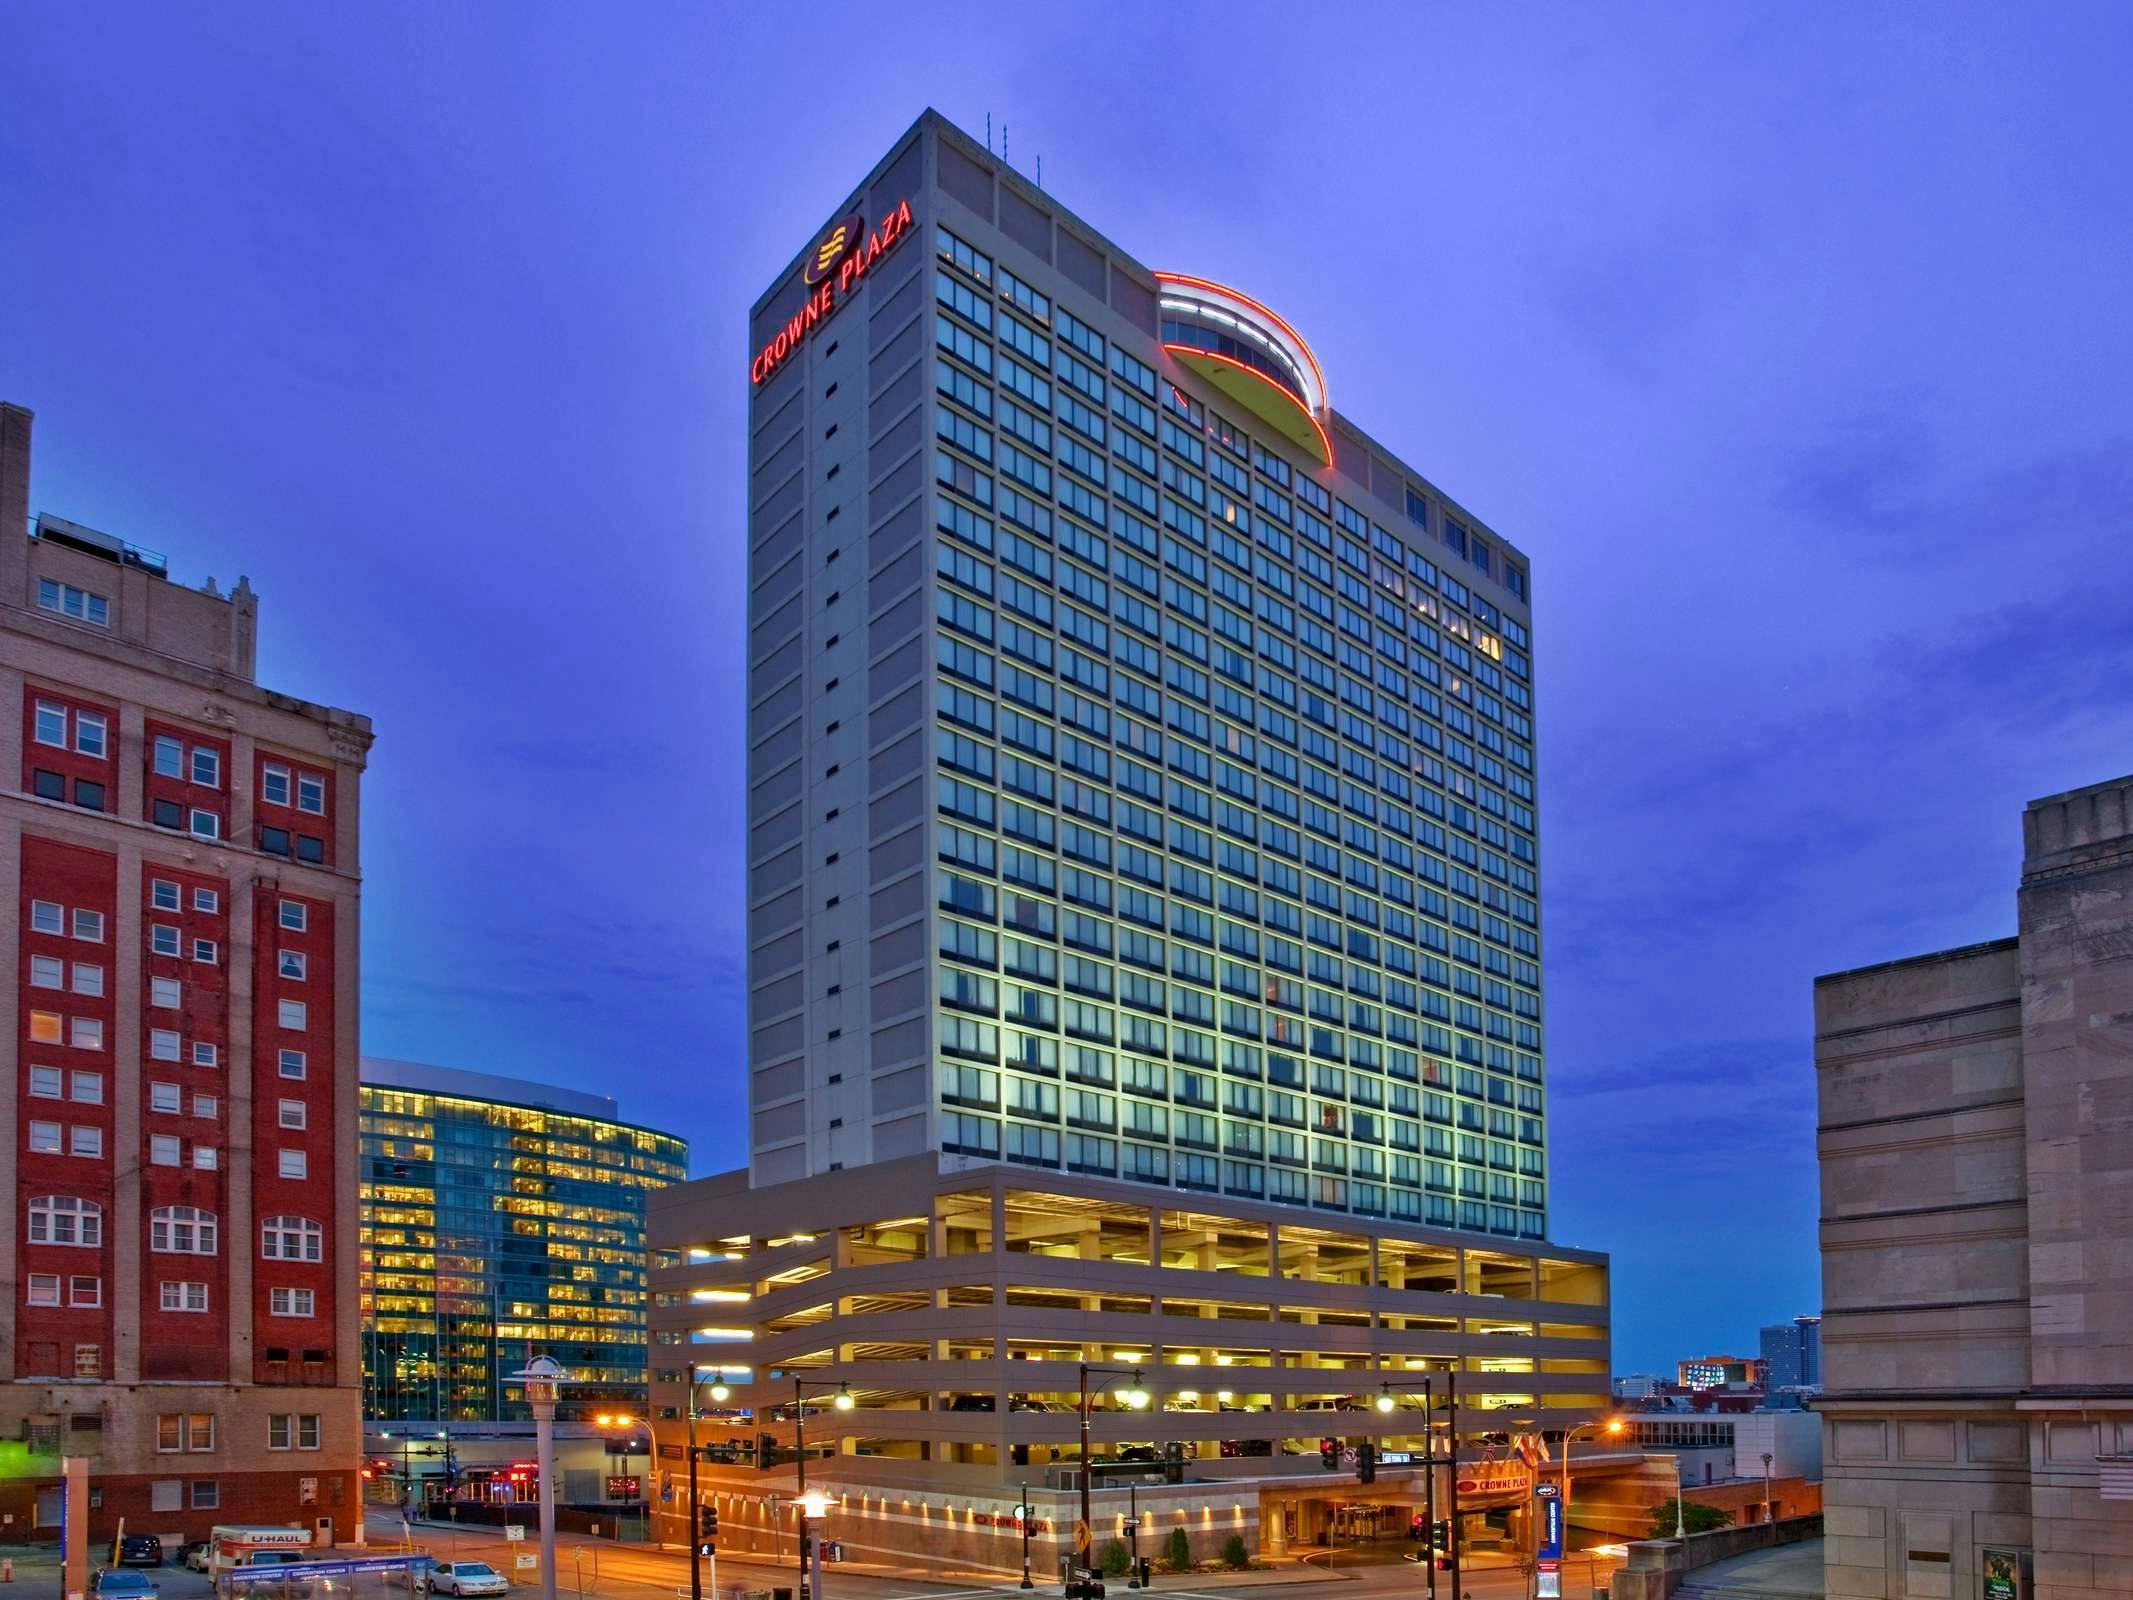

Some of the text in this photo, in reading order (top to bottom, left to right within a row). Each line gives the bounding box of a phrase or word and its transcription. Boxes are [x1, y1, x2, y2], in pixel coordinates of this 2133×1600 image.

[752, 200, 912, 384] CROWNE PLAZA
[1480, 1480, 1511, 1490] CROWNE
[252, 1535, 302, 1543] U-HAUL
[293, 1567, 346, 1577] CONVENTION CENTER
[355, 1564, 386, 1572] CONVENTION
